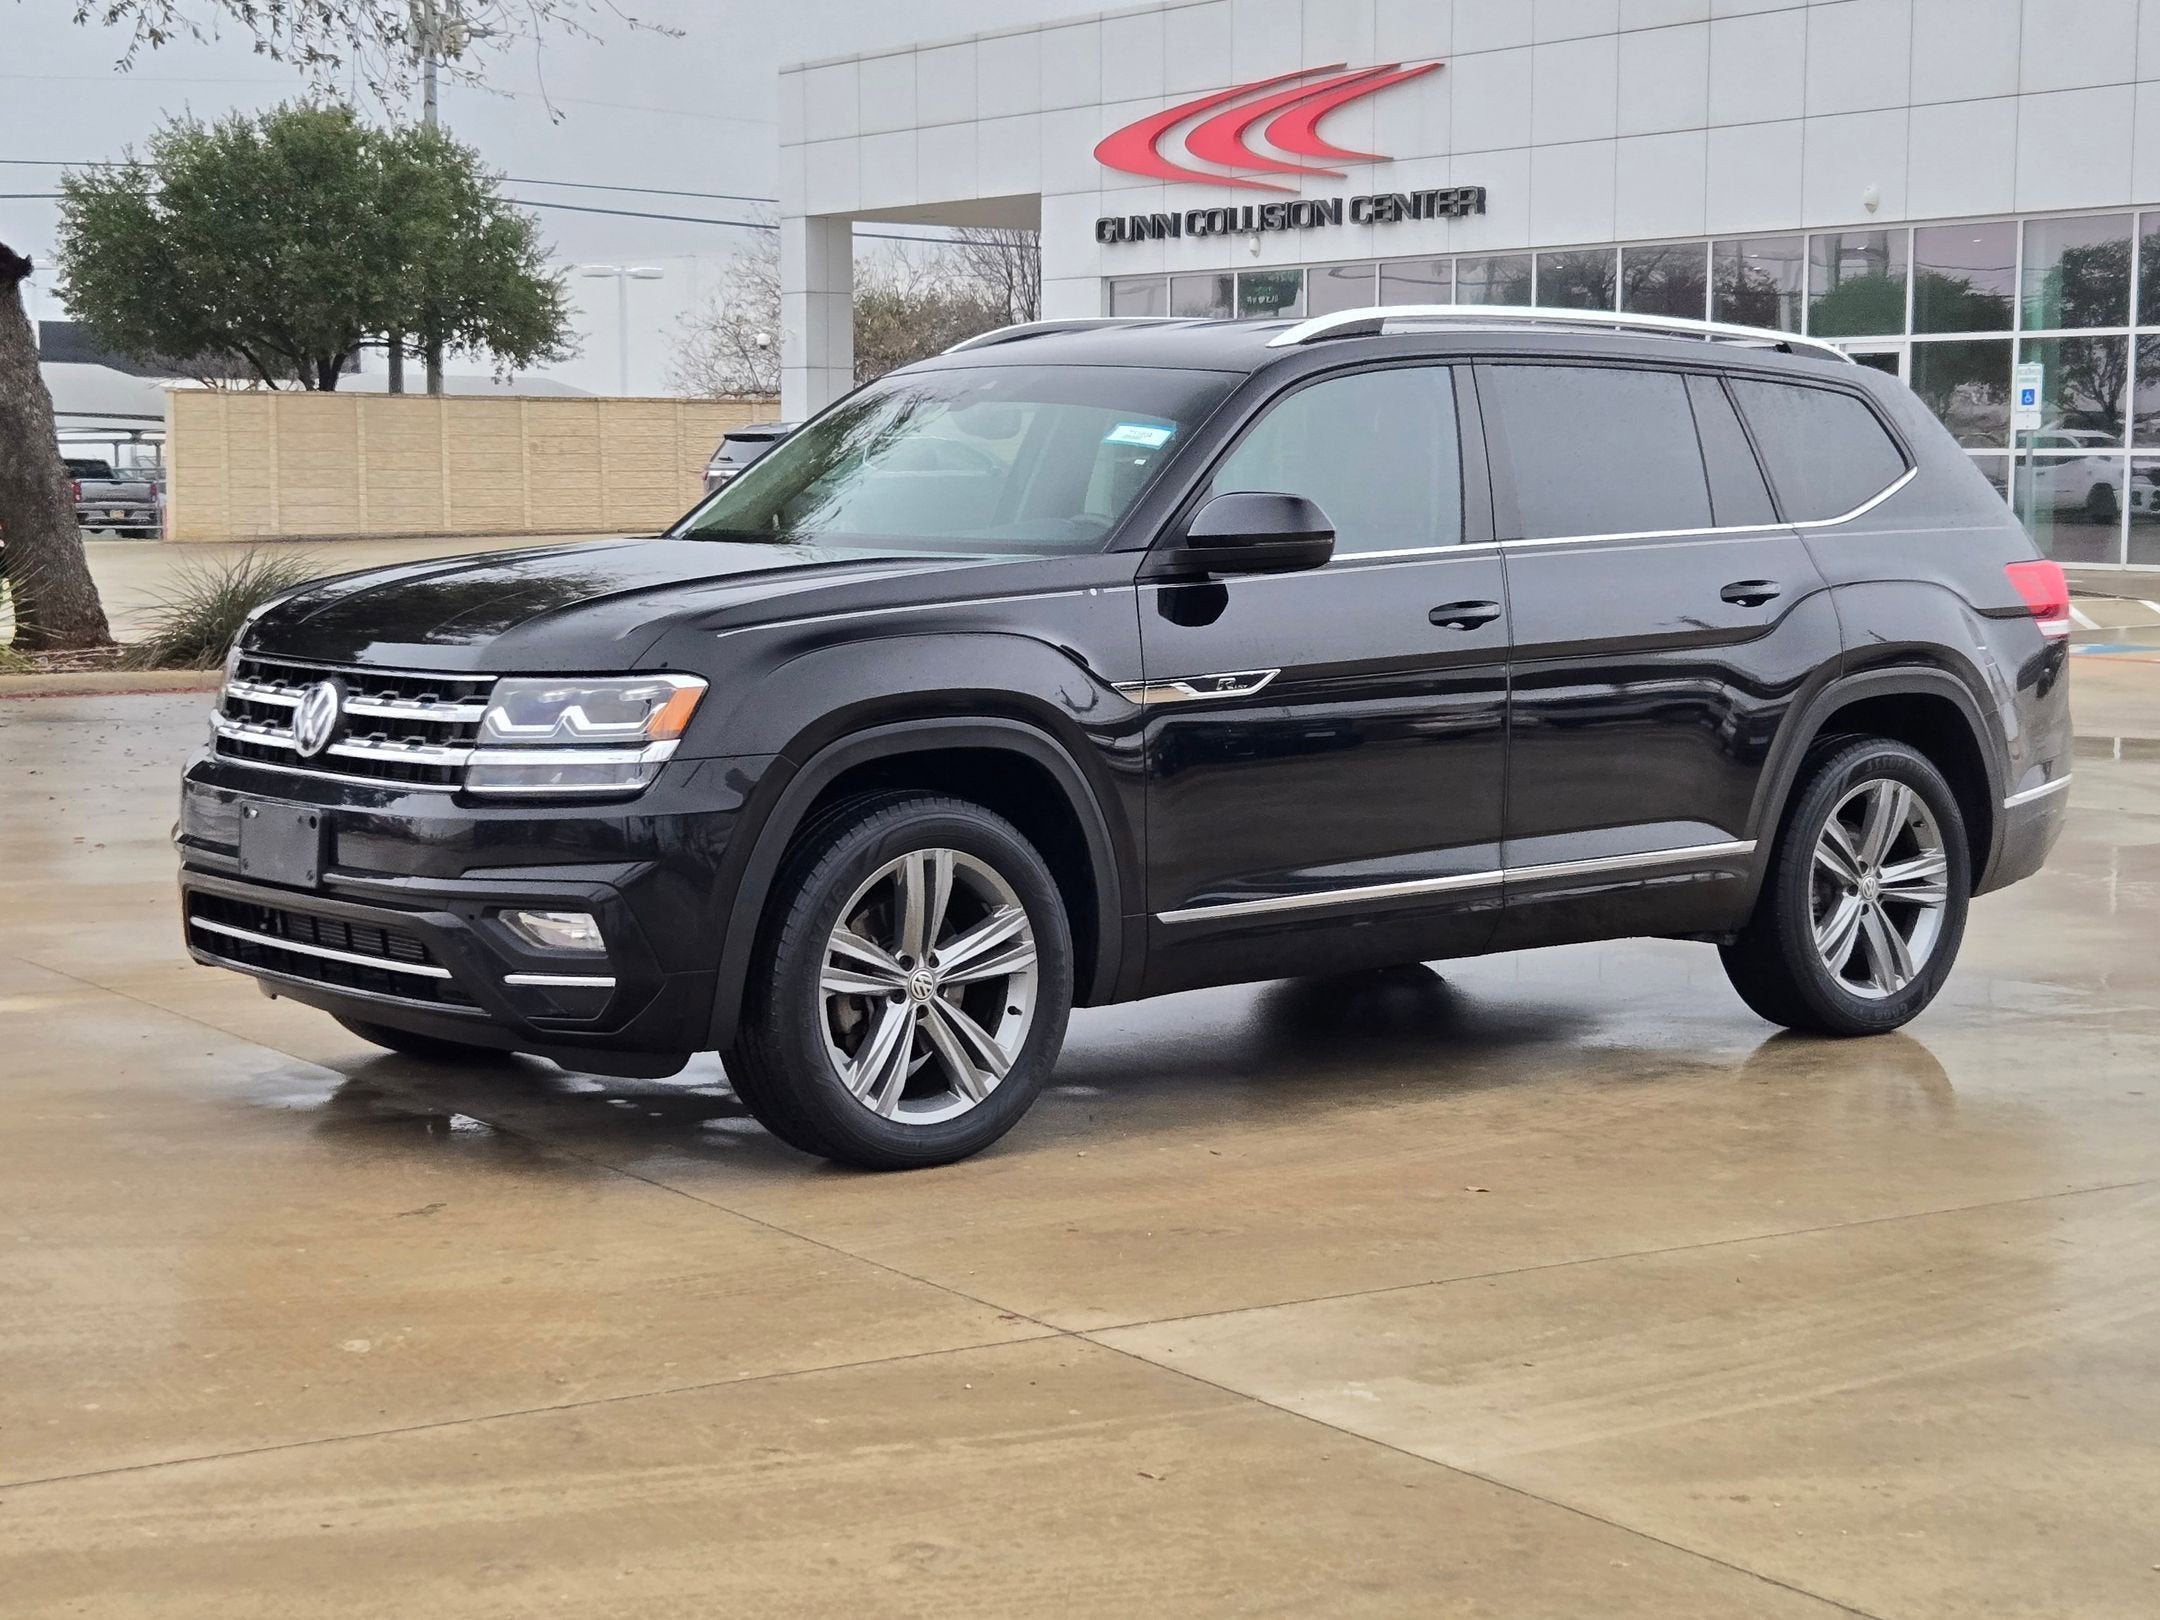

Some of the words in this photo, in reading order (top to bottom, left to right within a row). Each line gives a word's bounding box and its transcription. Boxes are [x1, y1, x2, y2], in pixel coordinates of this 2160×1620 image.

[1096, 212, 1182, 244] GUNN
[1185, 197, 1343, 238] COLLISION
[1349, 186, 1487, 225] CENTER
